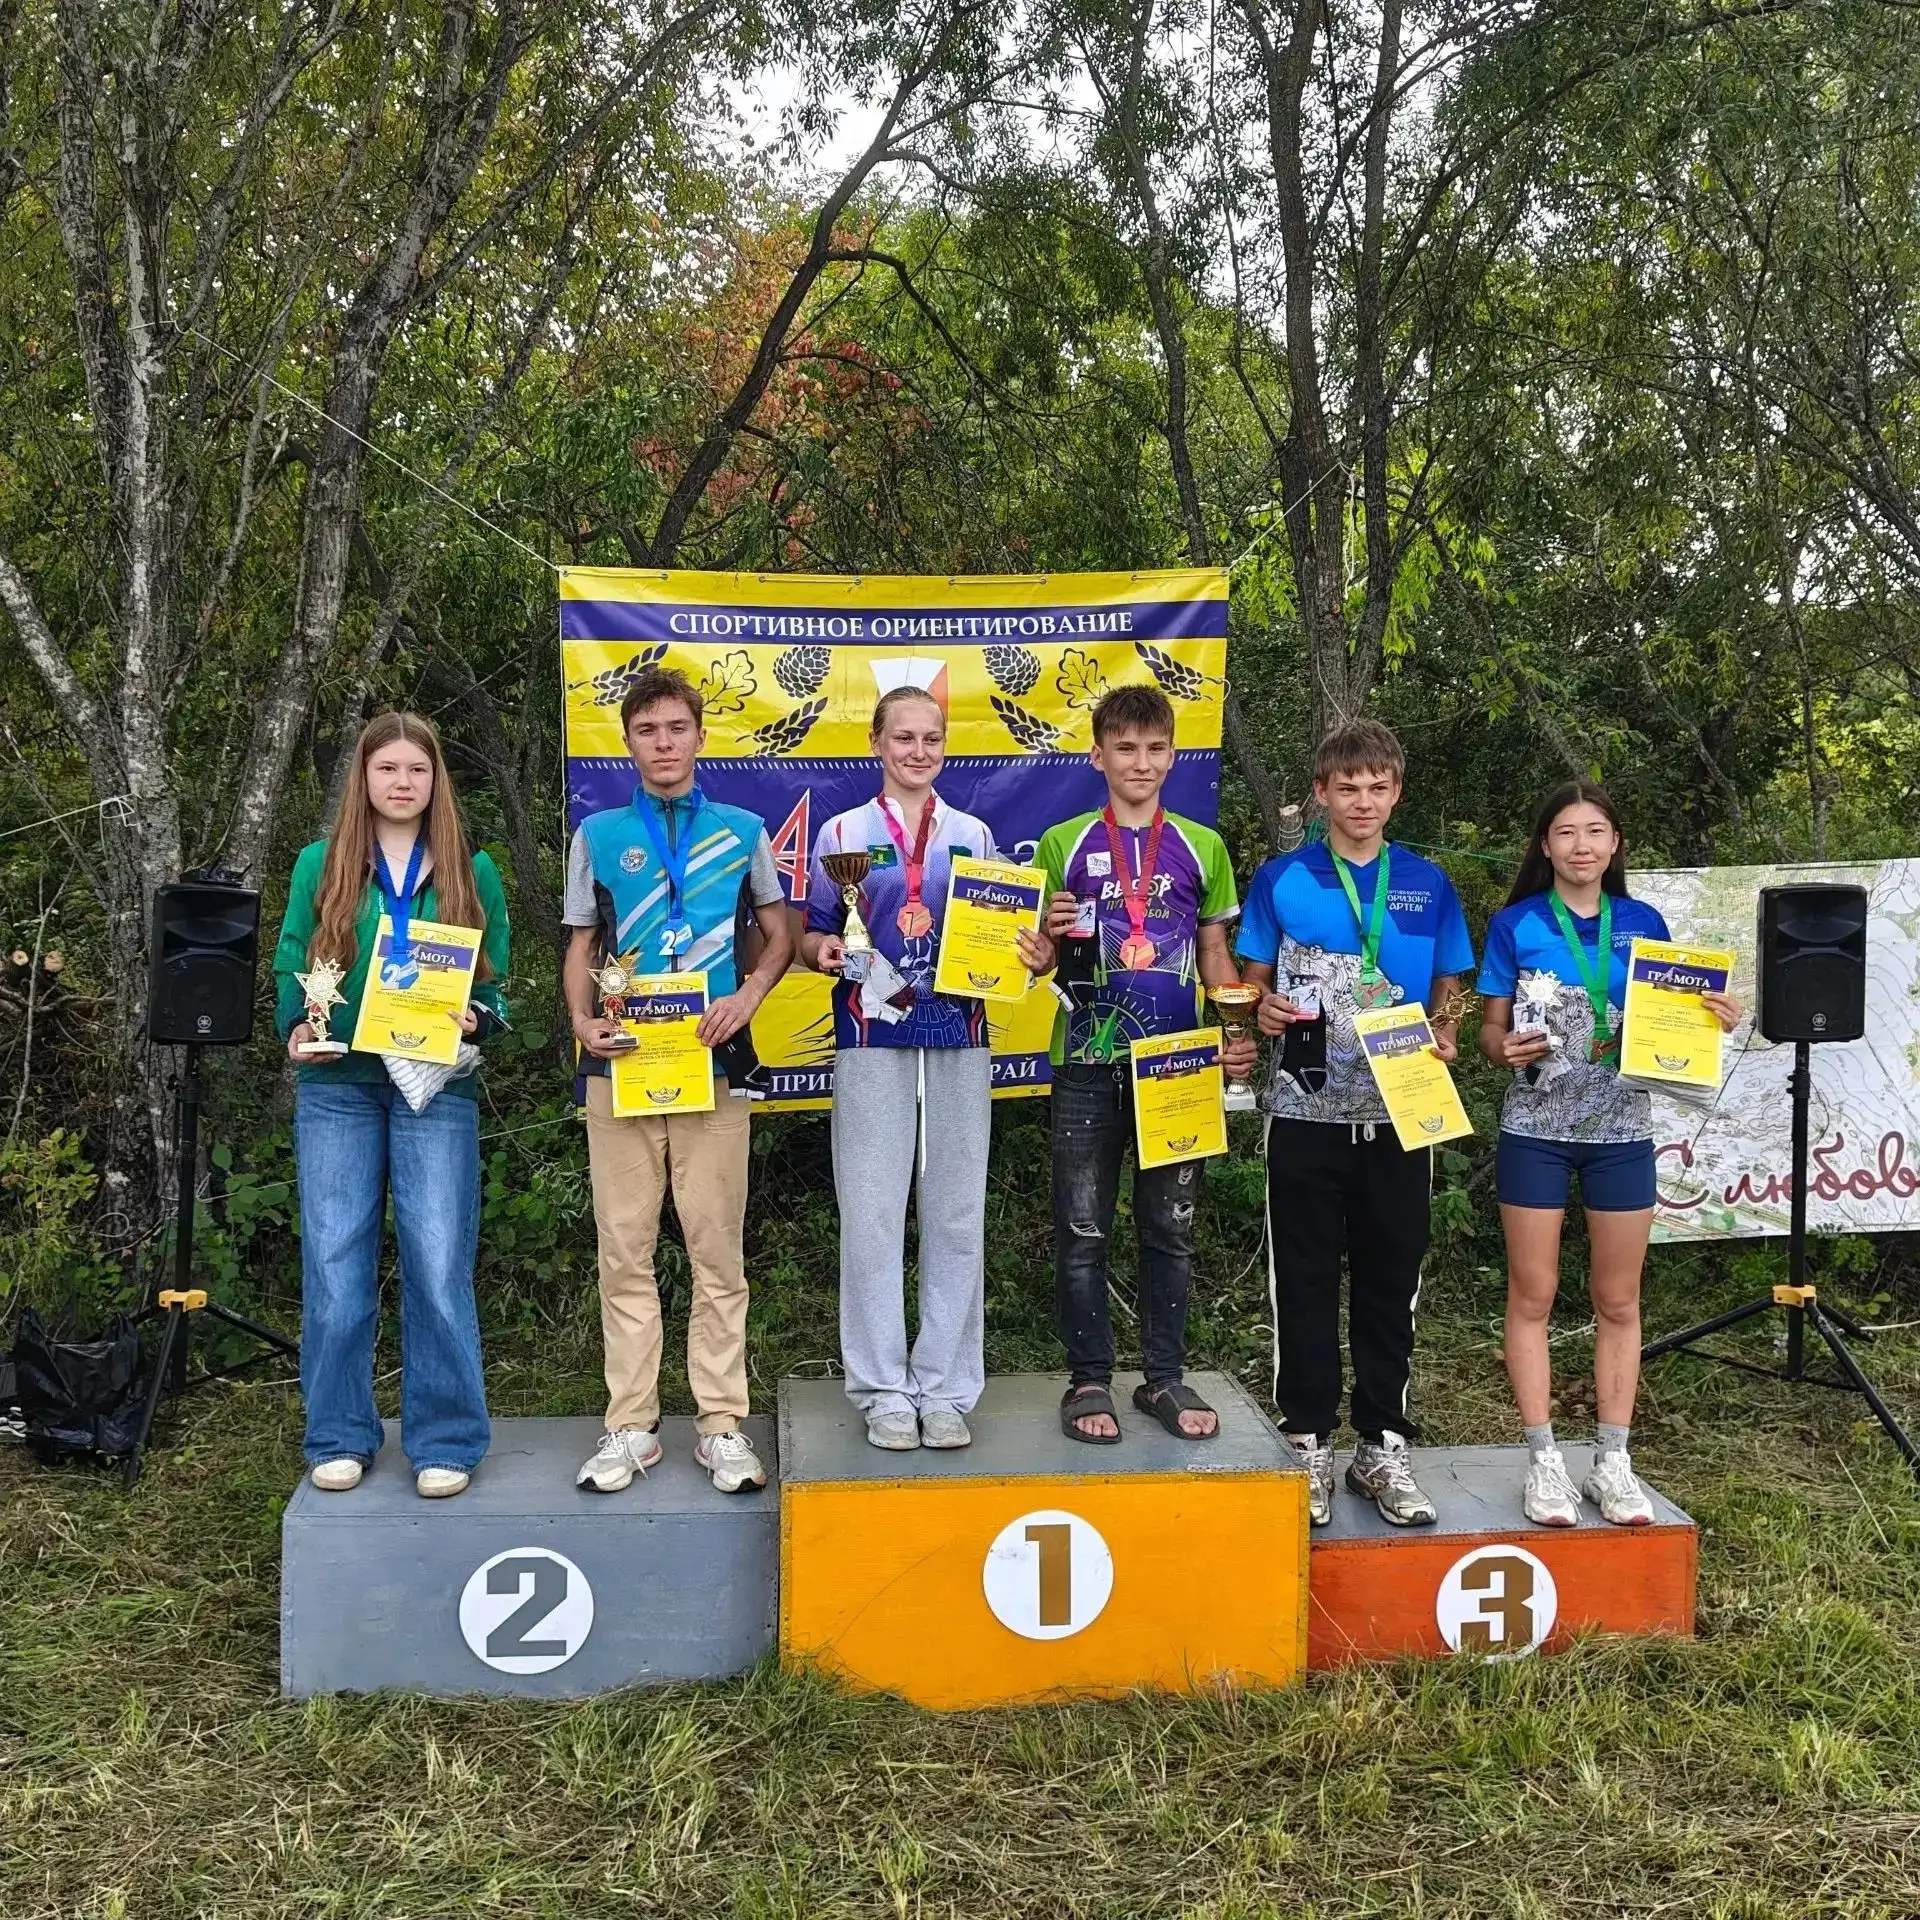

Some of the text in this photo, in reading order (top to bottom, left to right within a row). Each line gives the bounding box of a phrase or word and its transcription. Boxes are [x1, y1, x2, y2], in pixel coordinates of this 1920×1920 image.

[669, 611, 1134, 639] СПОРТИВНОЕ ОРИЕНТИРОВАНИЕ
[966, 884, 1024, 906] ГРАМОТА
[1143, 908, 1170, 919] ОБОЙ
[1389, 902, 1423, 912] АРТЕМ
[658, 929, 677, 956] 2
[405, 943, 457, 966] АМОТА
[380, 963, 401, 990] 2
[1647, 966, 1711, 988] ГРАМОТА
[627, 998, 691, 1016] ГРАМОТА
[1376, 1032, 1423, 1052] ГРАМОТА
[771, 1056, 1038, 1092] ПРИ РАЙ
[1149, 1055, 1206, 1075] ГРАМОТА
[1025, 1524, 1071, 1626] 1
[486, 1556, 568, 1658] 2
[1460, 1555, 1534, 1655] 3
